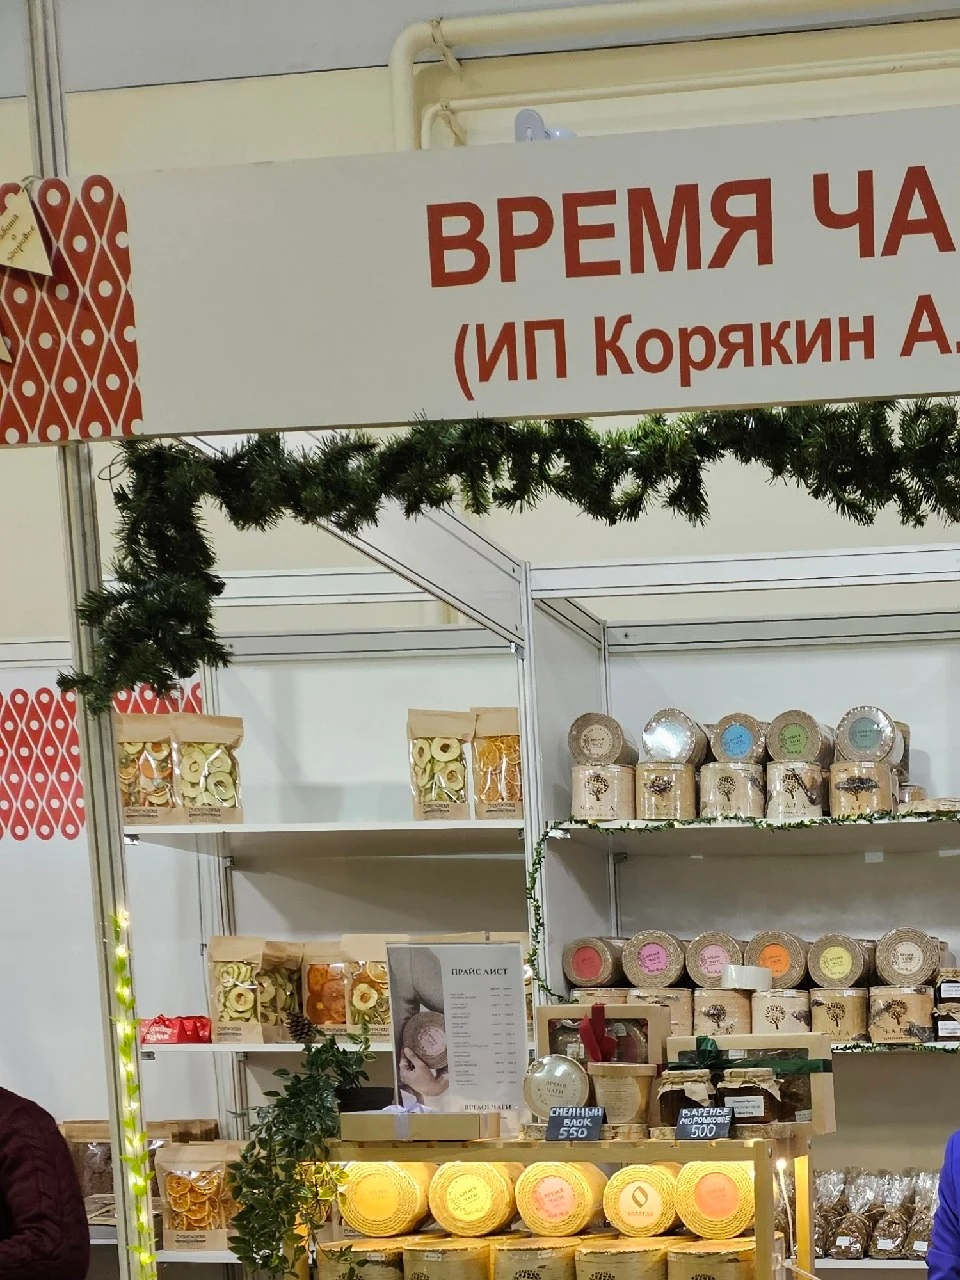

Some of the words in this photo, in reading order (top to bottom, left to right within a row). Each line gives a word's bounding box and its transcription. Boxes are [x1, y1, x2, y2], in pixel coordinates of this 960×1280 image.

[426, 178, 773, 288] ВРЕМЯ
[454, 318, 567, 401] (ИП
[594, 314, 875, 388] Корякин
[451, 967, 482, 976] ПРАЙС
[681, 1107, 731, 1117] ВАРЕНЬЕ
[563, 1118, 592, 1127] БЛОК
[558, 1127, 588, 1139] 550
[690, 1124, 717, 1138] 500
